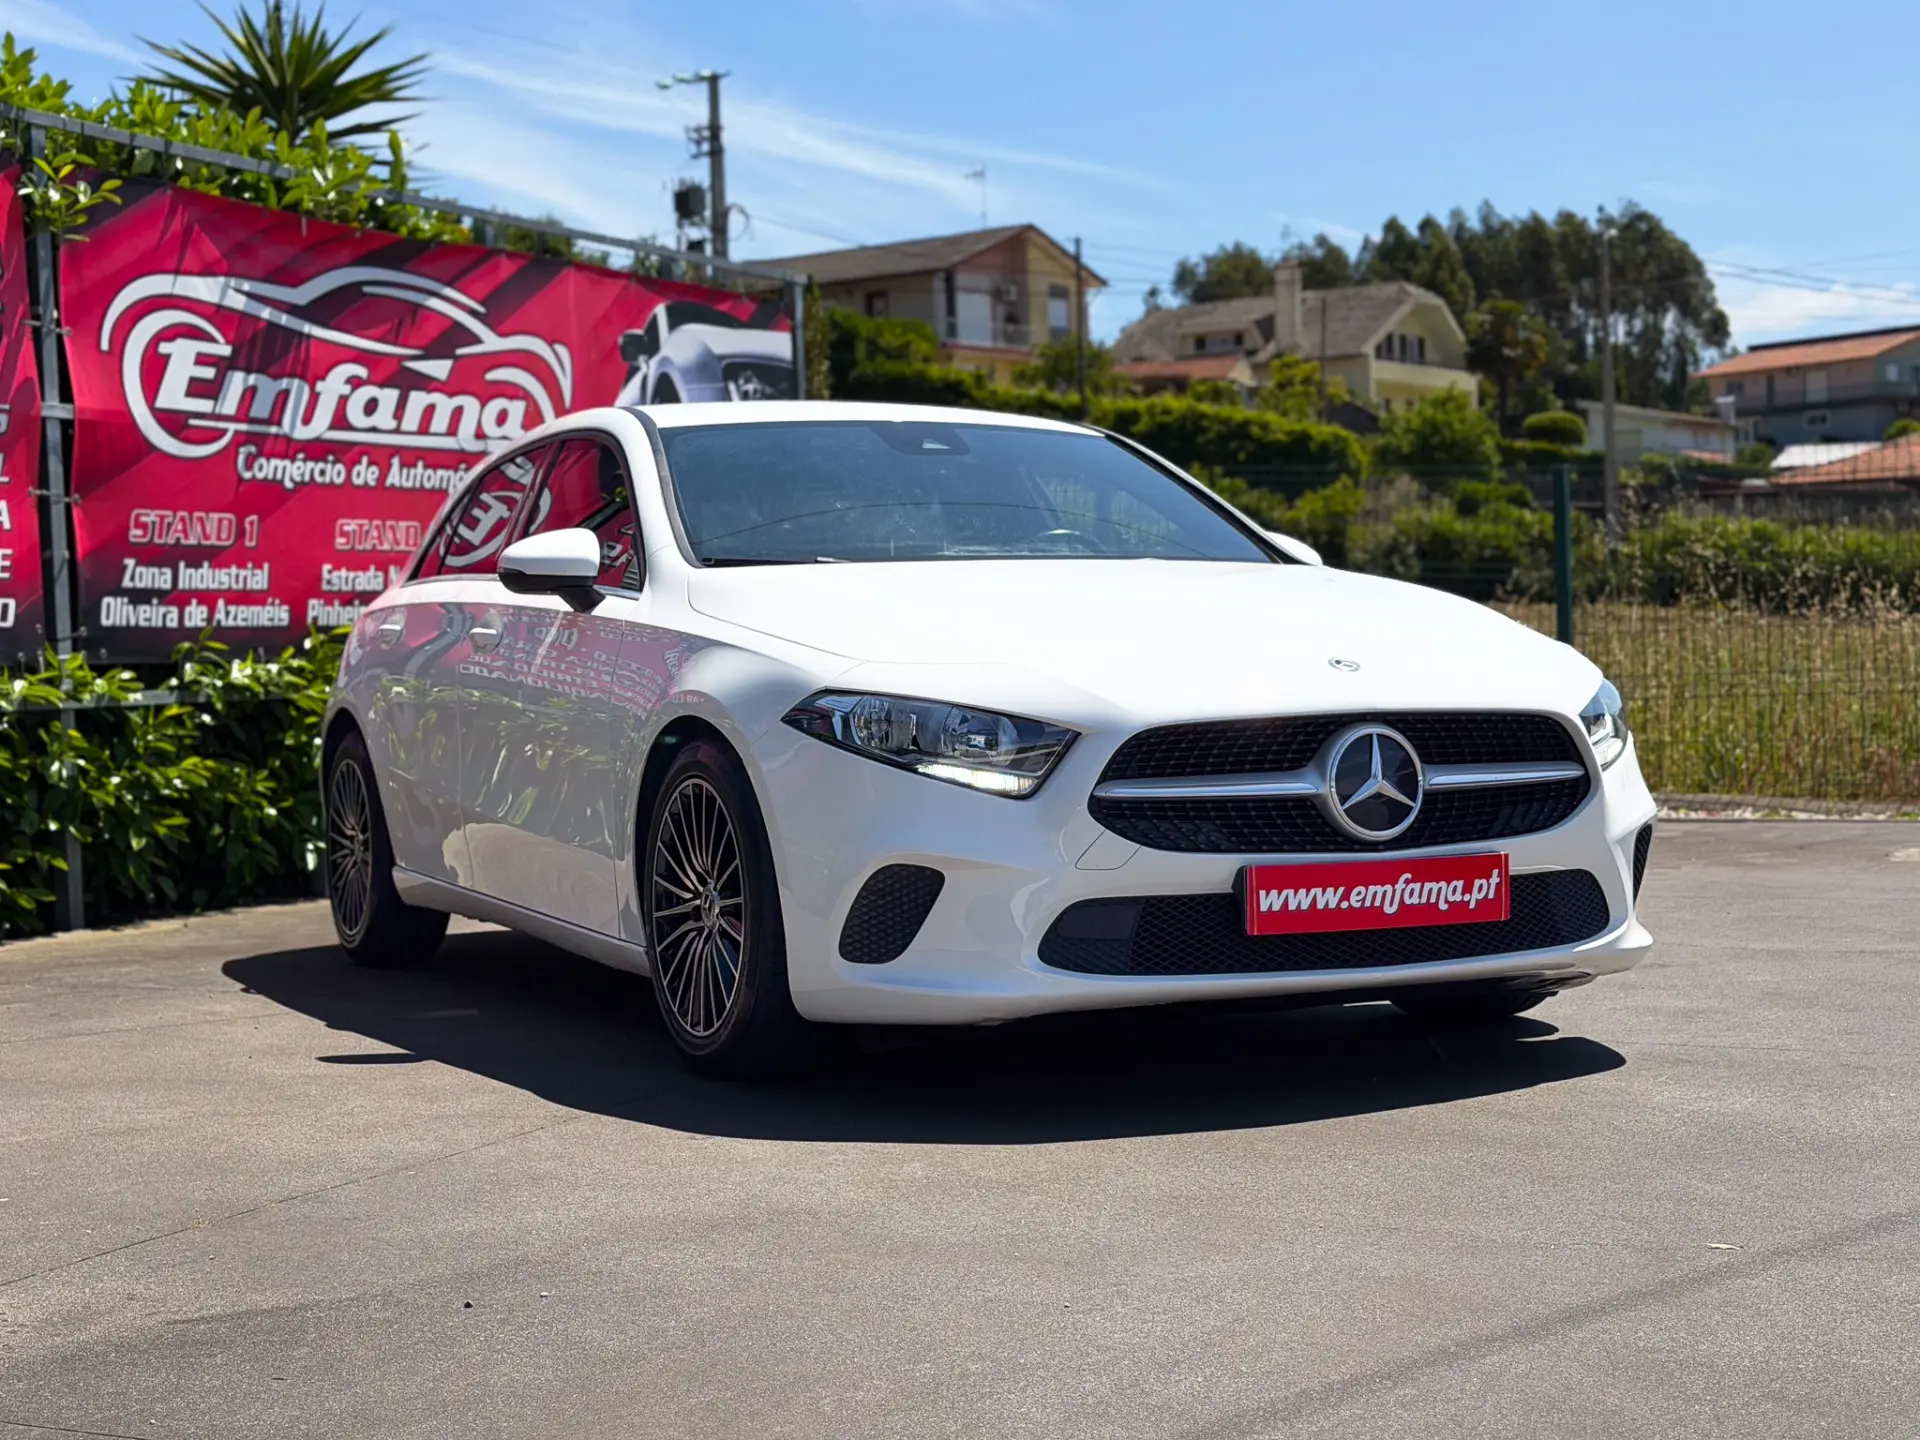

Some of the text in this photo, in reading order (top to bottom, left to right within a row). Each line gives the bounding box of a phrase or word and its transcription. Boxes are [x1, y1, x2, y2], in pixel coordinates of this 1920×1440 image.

[155, 337, 527, 453] Emfama
[236, 445, 346, 490] Comércio
[351, 456, 379, 486] de
[129, 508, 260, 547] STAND 1
[121, 558, 270, 591] Zona Industrial
[321, 564, 385, 593] Estrada
[100, 596, 291, 628] Oliveira de Azeméis
[1258, 869, 1500, 914] www.emfama.pt
